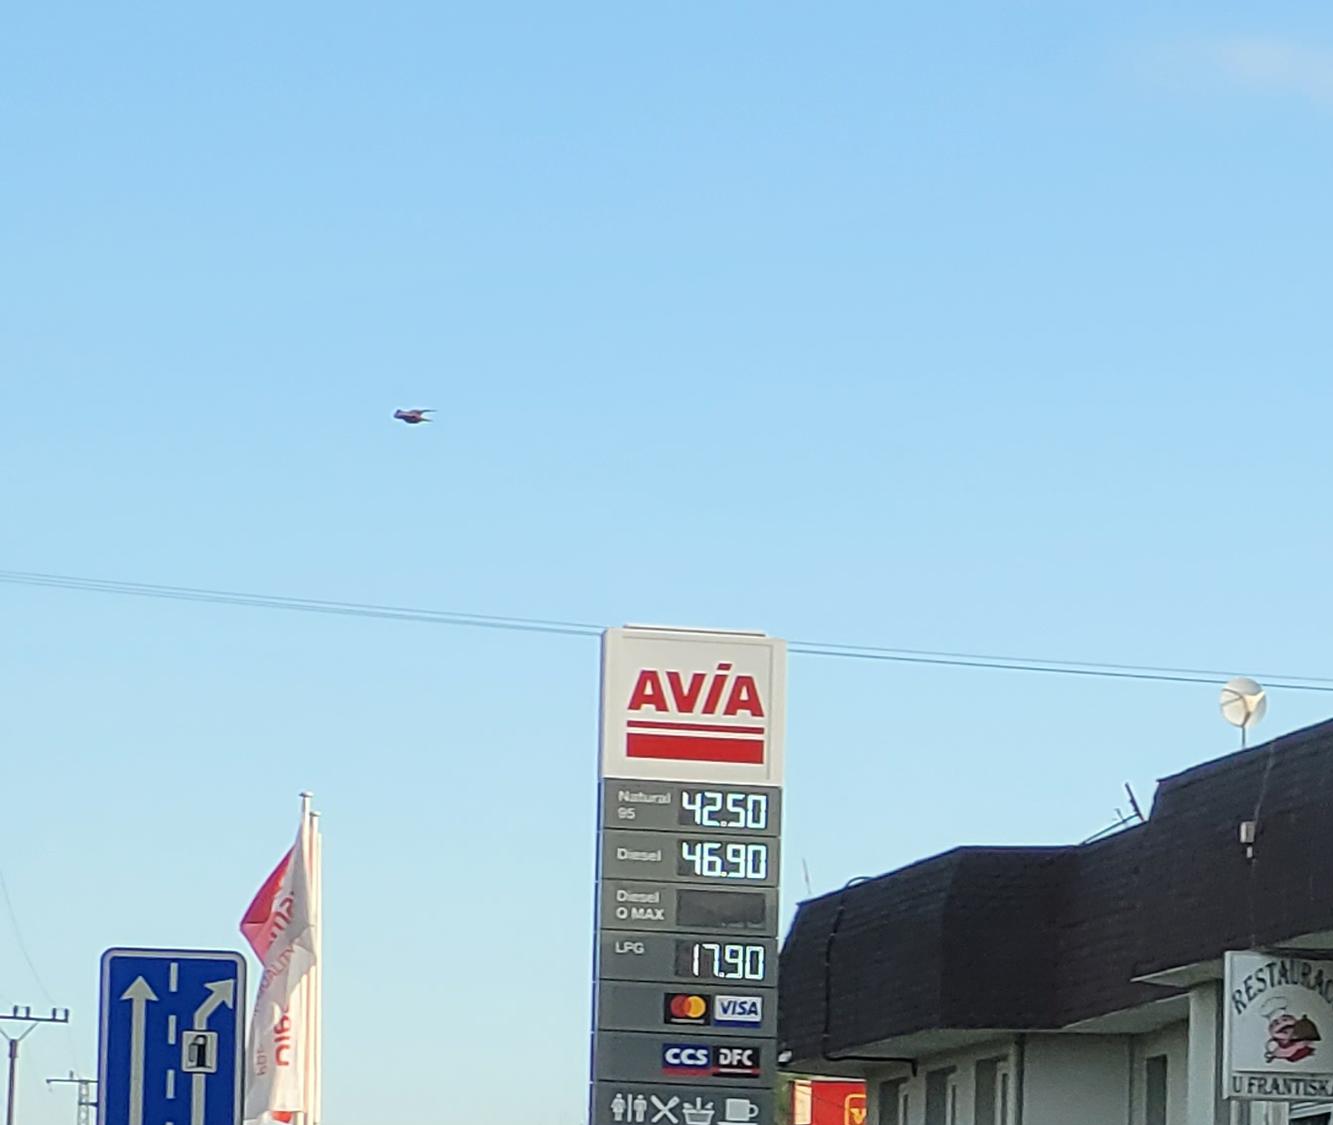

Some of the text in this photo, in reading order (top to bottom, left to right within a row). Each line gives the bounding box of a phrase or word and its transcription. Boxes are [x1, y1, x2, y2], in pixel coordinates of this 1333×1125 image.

[618, 790, 671, 804] Natural
[617, 806, 636, 819] 95
[682, 791, 768, 829] 42.50
[616, 847, 661, 862] Diesel
[682, 841, 768, 880] 46.90
[616, 889, 660, 903] Diesel
[631, 907, 665, 921] MAX
[615, 940, 645, 955] LPG
[692, 942, 766, 980] 17.90
[719, 999, 758, 1016] VISA
[664, 1047, 753, 1066] CCS DFC
[1232, 1076, 1243, 1093] U
